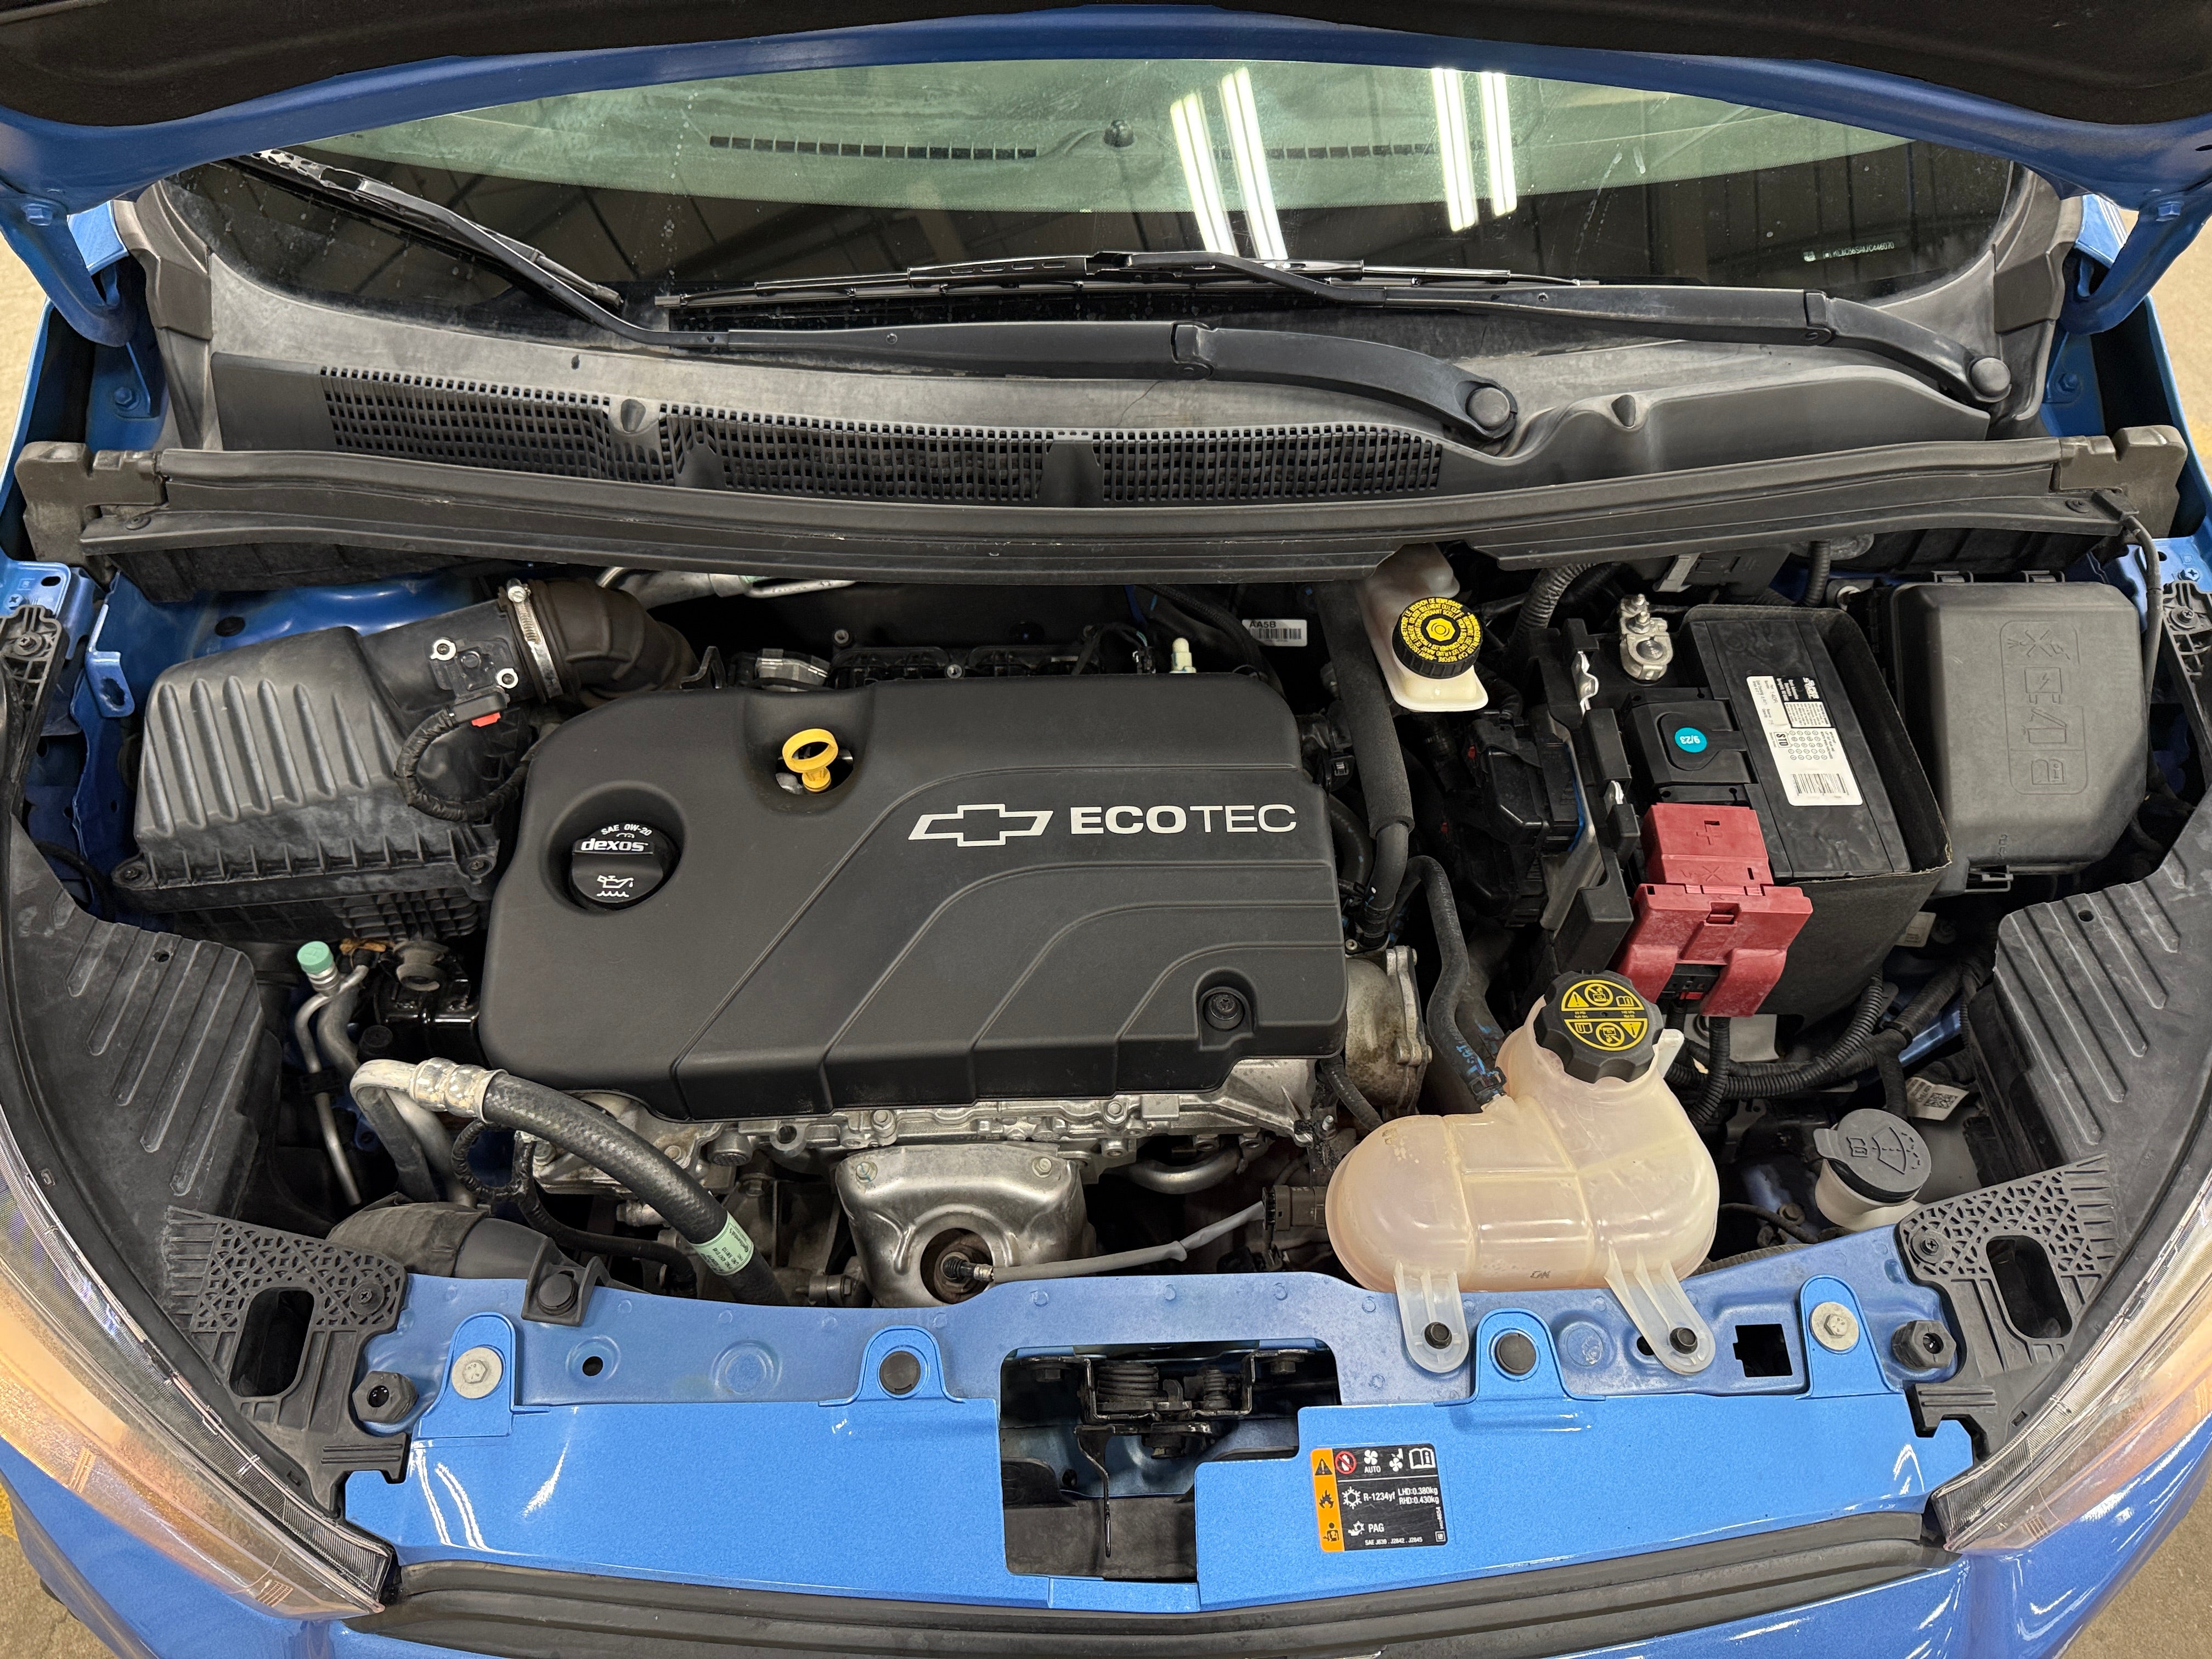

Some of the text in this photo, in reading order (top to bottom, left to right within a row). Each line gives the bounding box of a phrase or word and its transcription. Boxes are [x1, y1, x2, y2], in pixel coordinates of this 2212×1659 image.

[1457, 651, 1468, 659] CAP
[1680, 735, 1701, 744] 9/23
[1776, 733, 1789, 746] STD
[1070, 804, 1297, 834] ECOTEC
[601, 823, 652, 836] SAE 0W-20
[581, 838, 648, 851] dexos
[1397, 1486, 1438, 1496] LHD:0.380kg
[1363, 1491, 1396, 1502] R-1234yf
[1399, 1496, 1440, 1505] RHD:0.430kg
[1368, 1523, 1385, 1533] PAG
